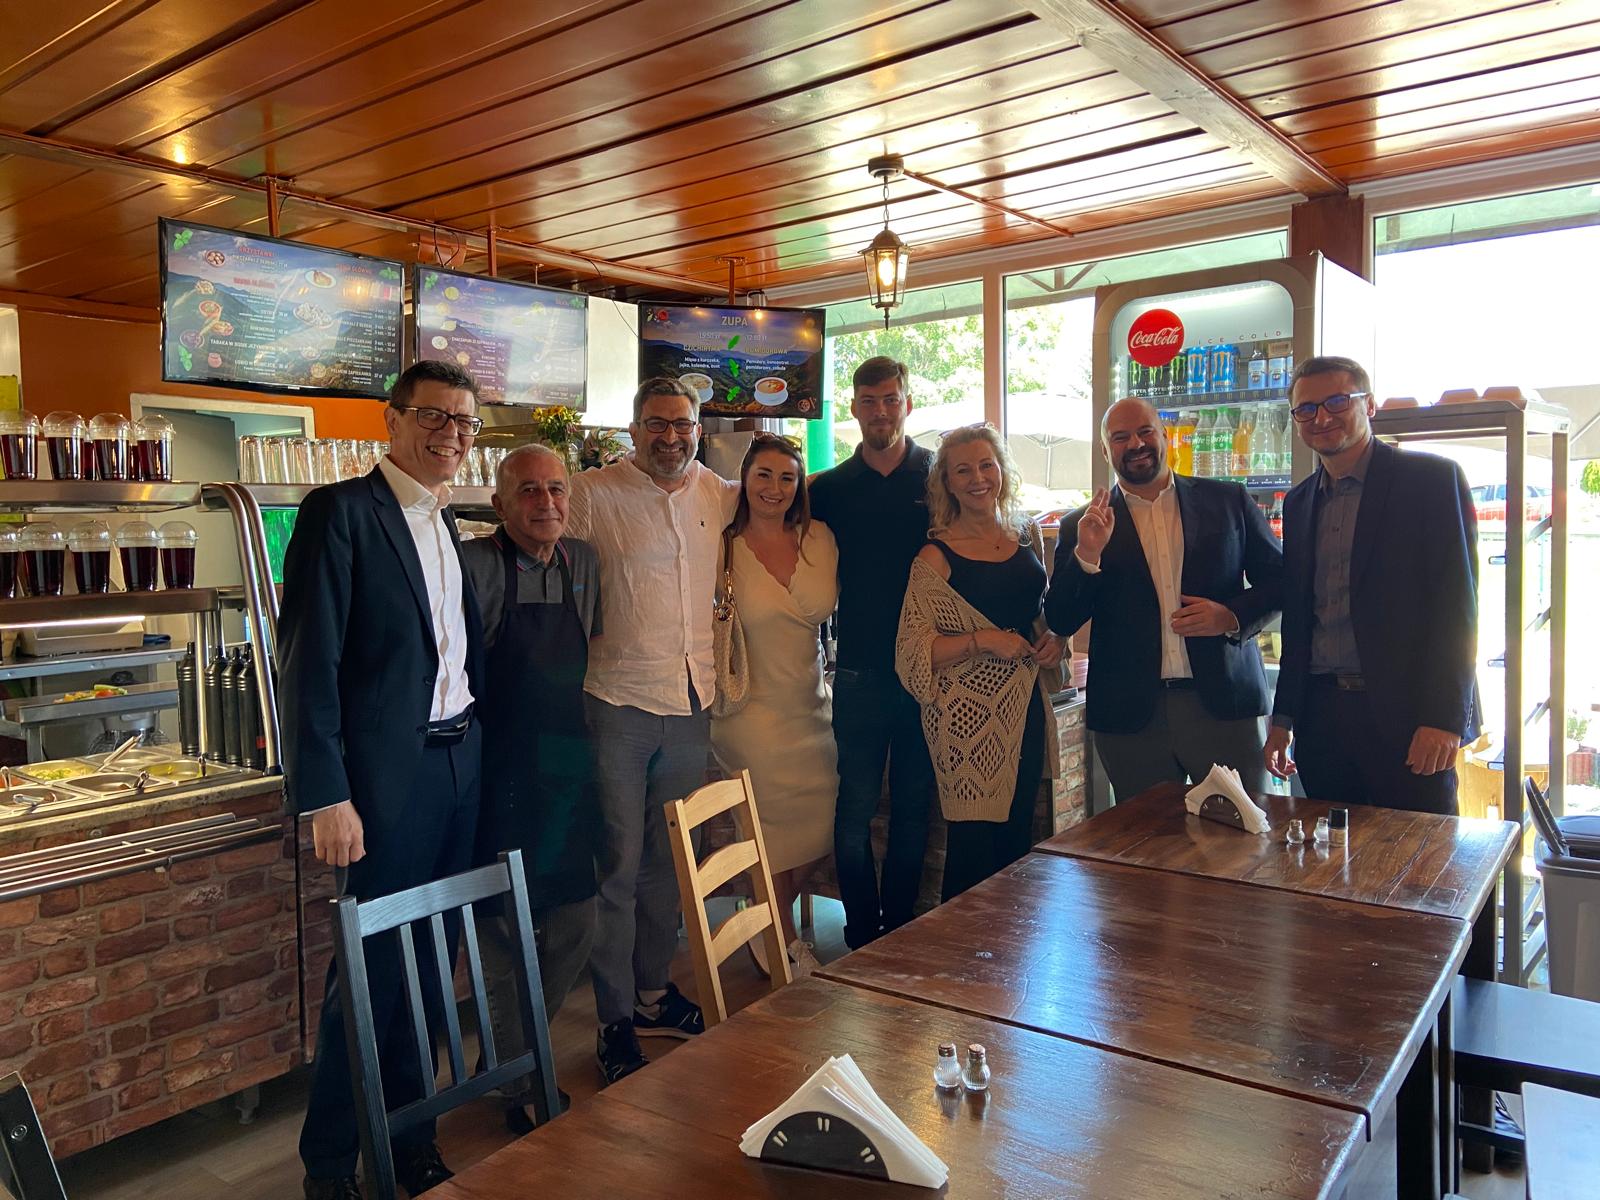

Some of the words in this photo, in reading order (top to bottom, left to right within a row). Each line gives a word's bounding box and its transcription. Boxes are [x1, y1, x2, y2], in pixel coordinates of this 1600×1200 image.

[721, 316, 748, 326] ZUPA
[1130, 326, 1182, 349] Coca-Cola
[1198, 337, 1225, 346] ICE
[1239, 330, 1282, 342] COLD
